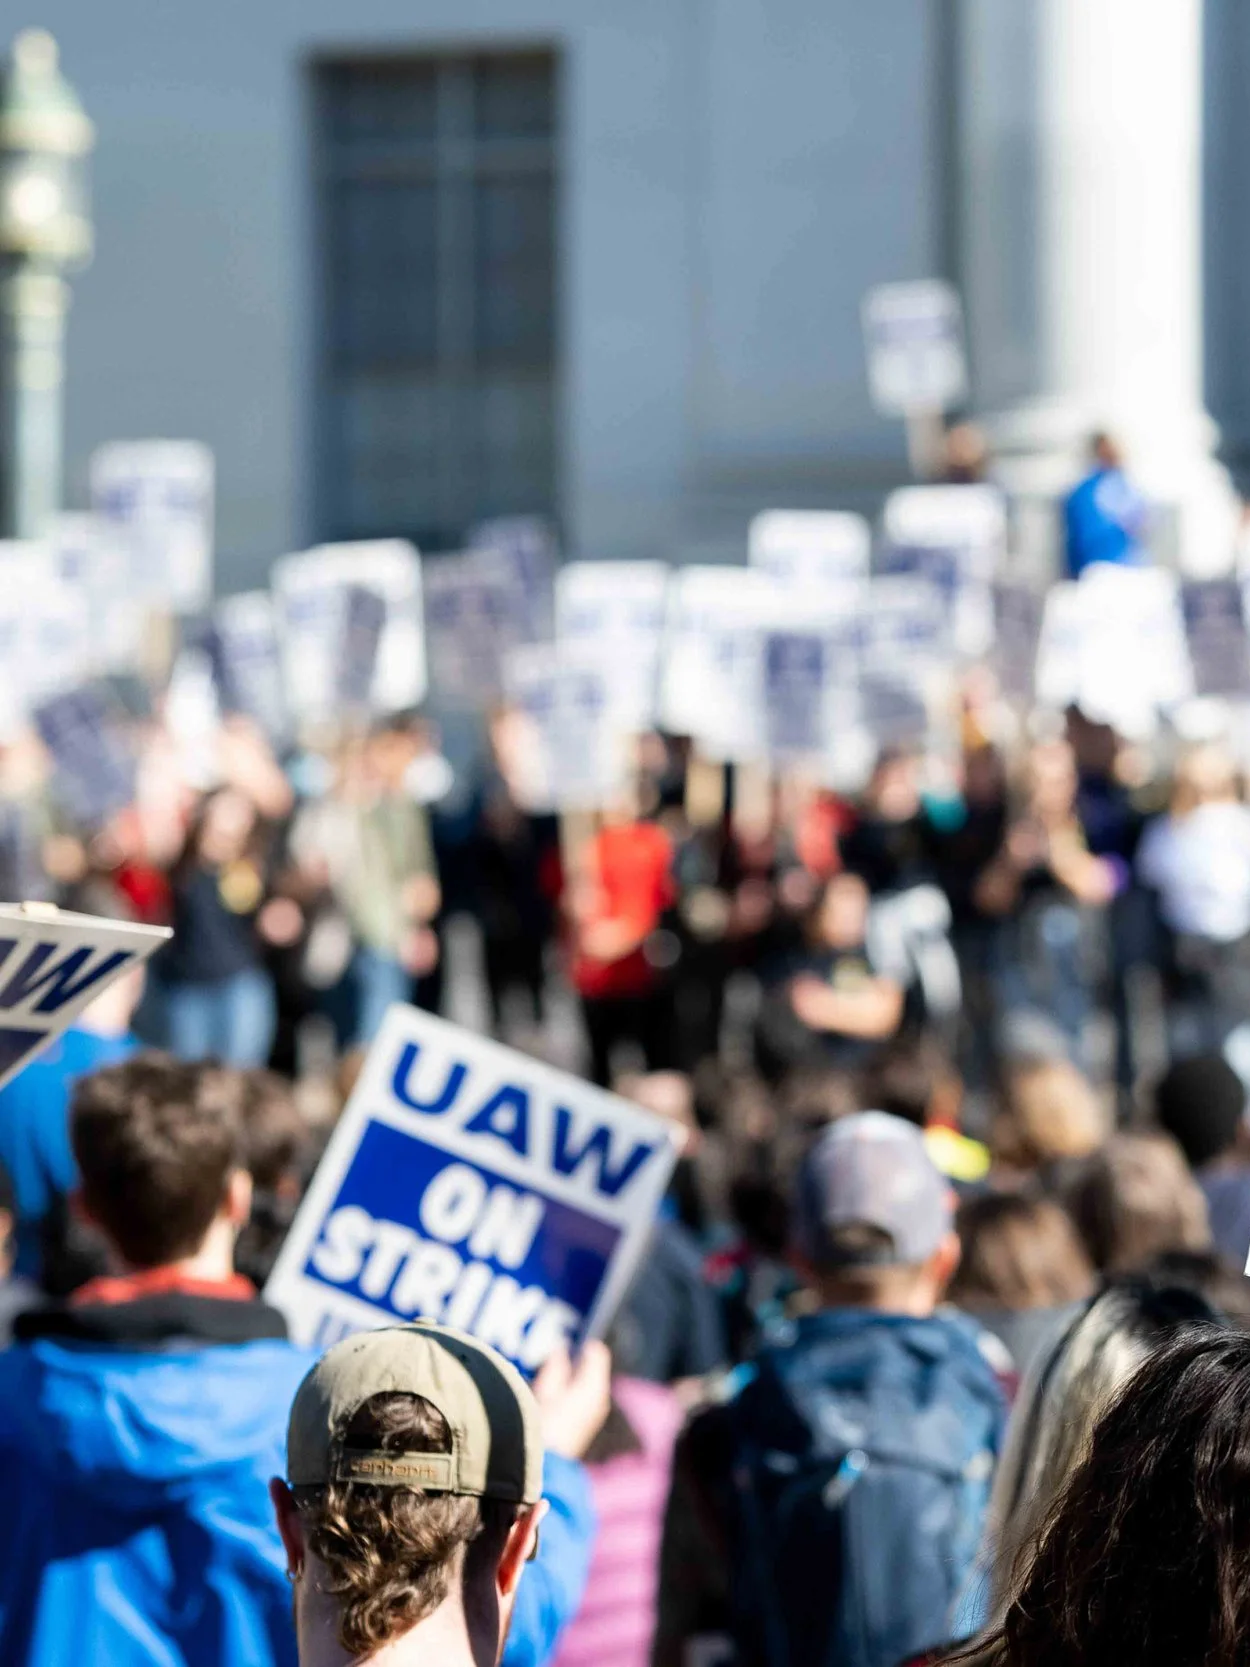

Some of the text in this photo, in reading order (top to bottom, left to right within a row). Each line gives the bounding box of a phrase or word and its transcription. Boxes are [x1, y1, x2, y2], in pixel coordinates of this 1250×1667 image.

[392, 1041, 655, 1198] UAW
[312, 1205, 584, 1369] STRIKE
[419, 1161, 546, 1271] ON
